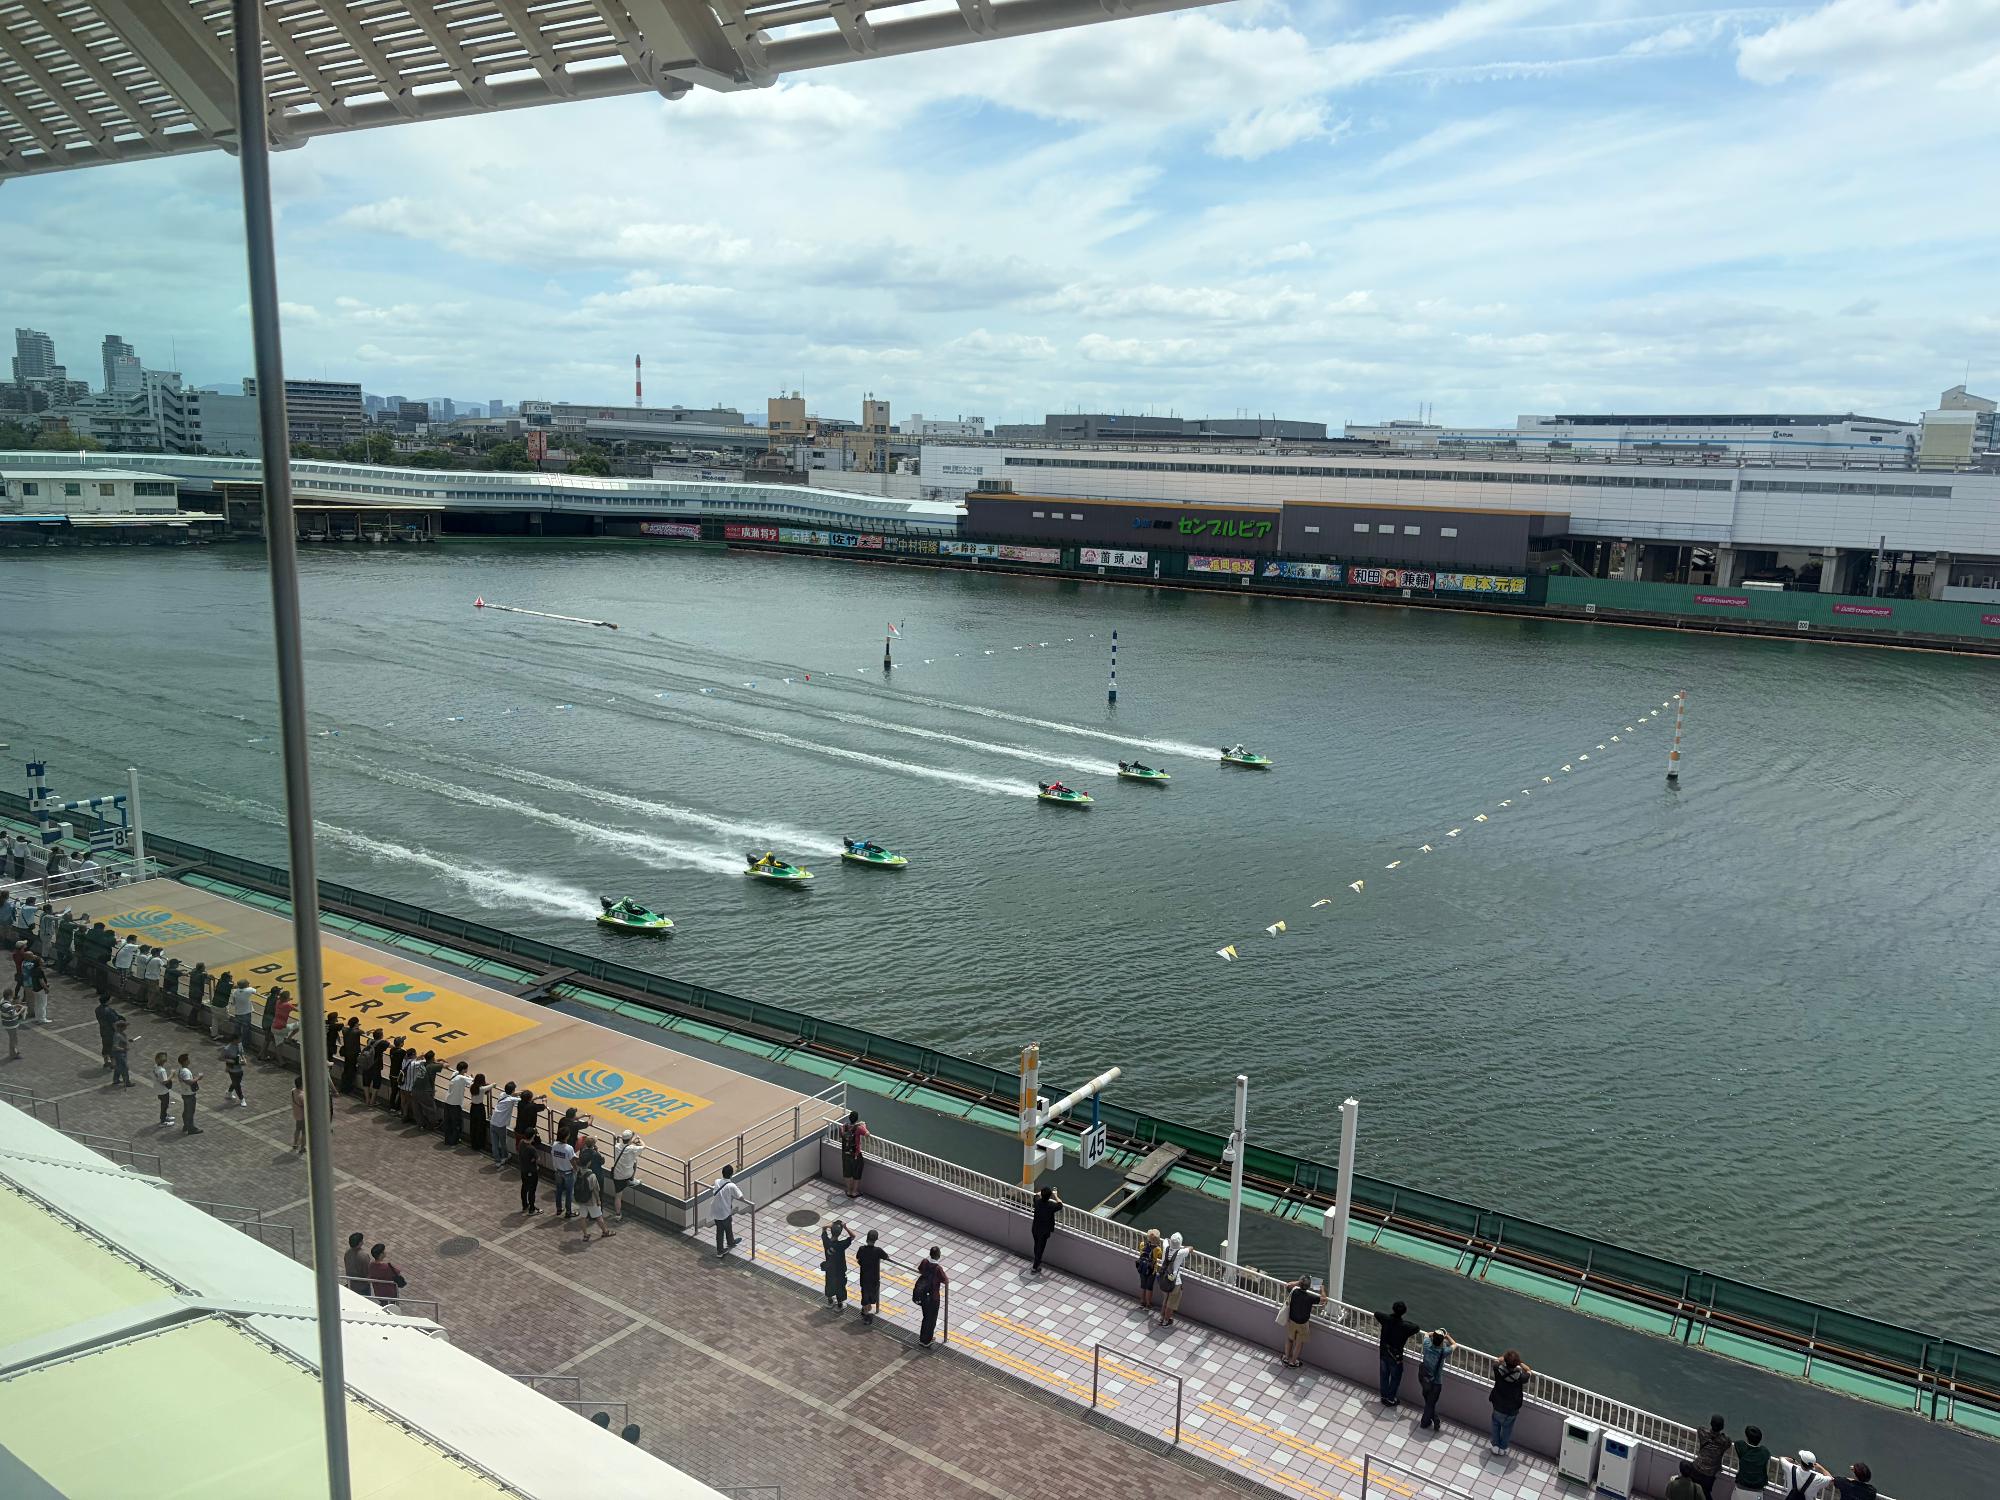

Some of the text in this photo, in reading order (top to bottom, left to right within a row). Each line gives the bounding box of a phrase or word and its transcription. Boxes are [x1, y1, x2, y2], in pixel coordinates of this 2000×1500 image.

[596, 1097, 668, 1123] RACE
[623, 1088, 694, 1113] BOAT
[1088, 1129, 1105, 1162] 45
